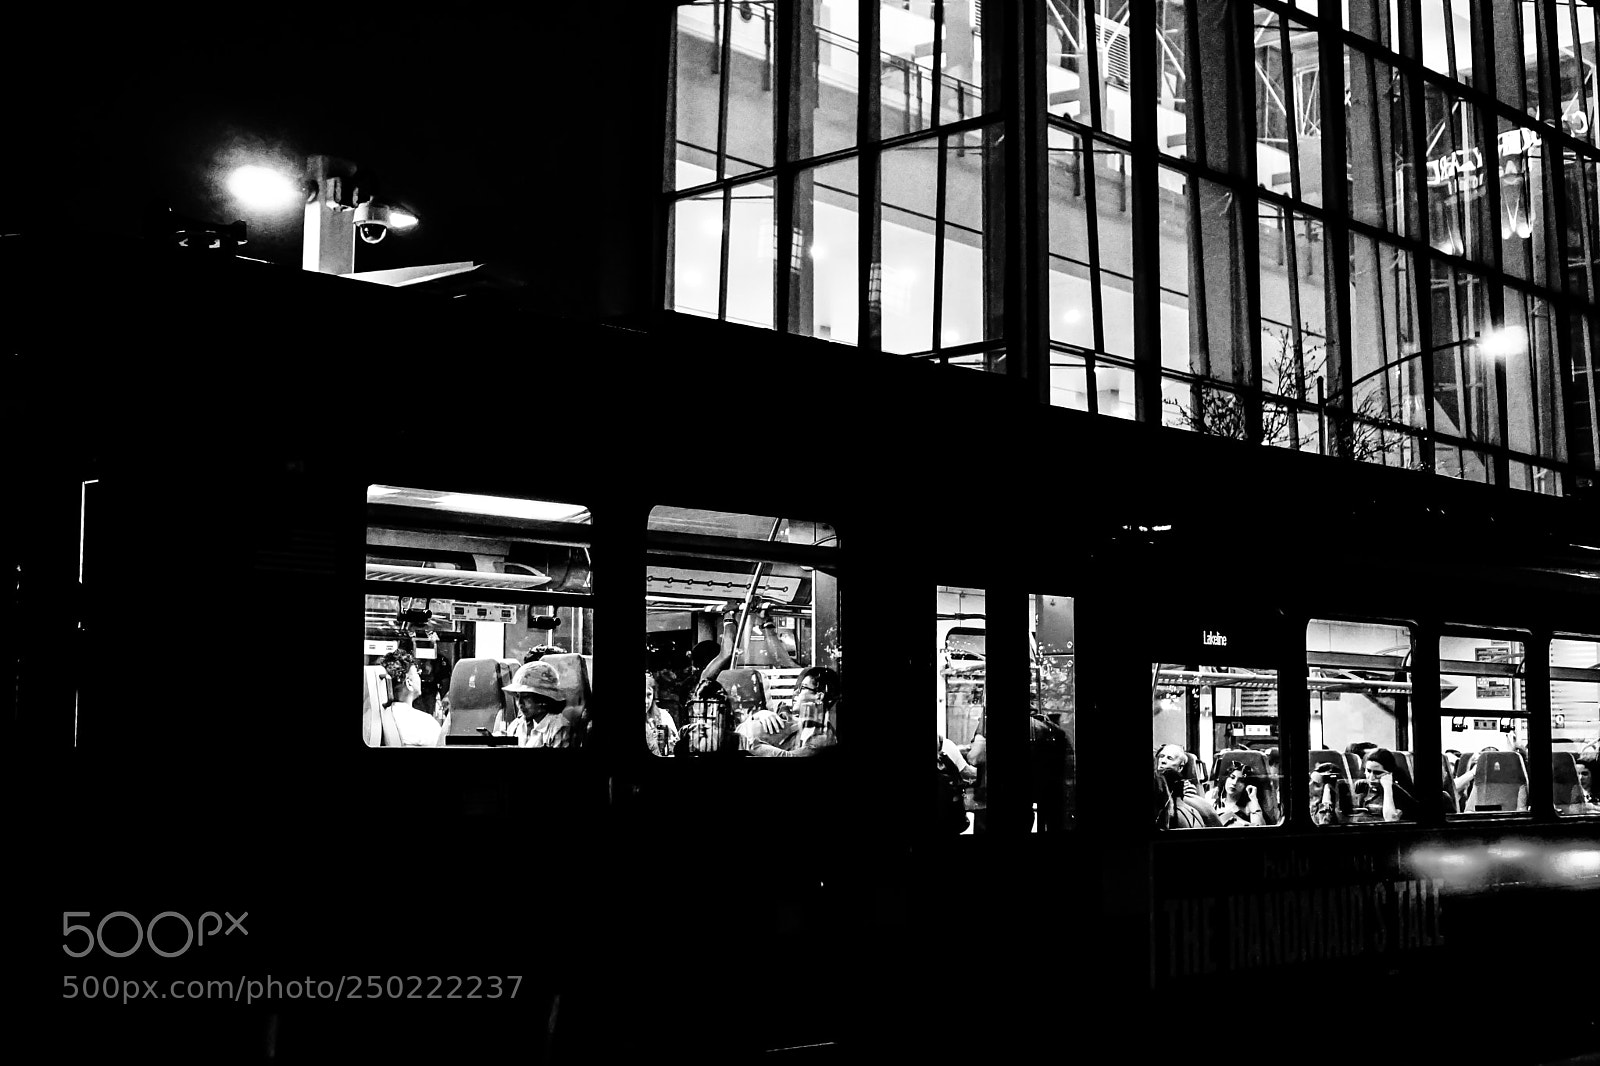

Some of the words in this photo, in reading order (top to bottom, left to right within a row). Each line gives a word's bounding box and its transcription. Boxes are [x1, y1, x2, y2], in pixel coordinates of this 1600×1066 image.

[1164, 897, 1217, 977] THE
[1228, 882, 1386, 971] HANDMAID'S
[1393, 878, 1445, 949] TALE
